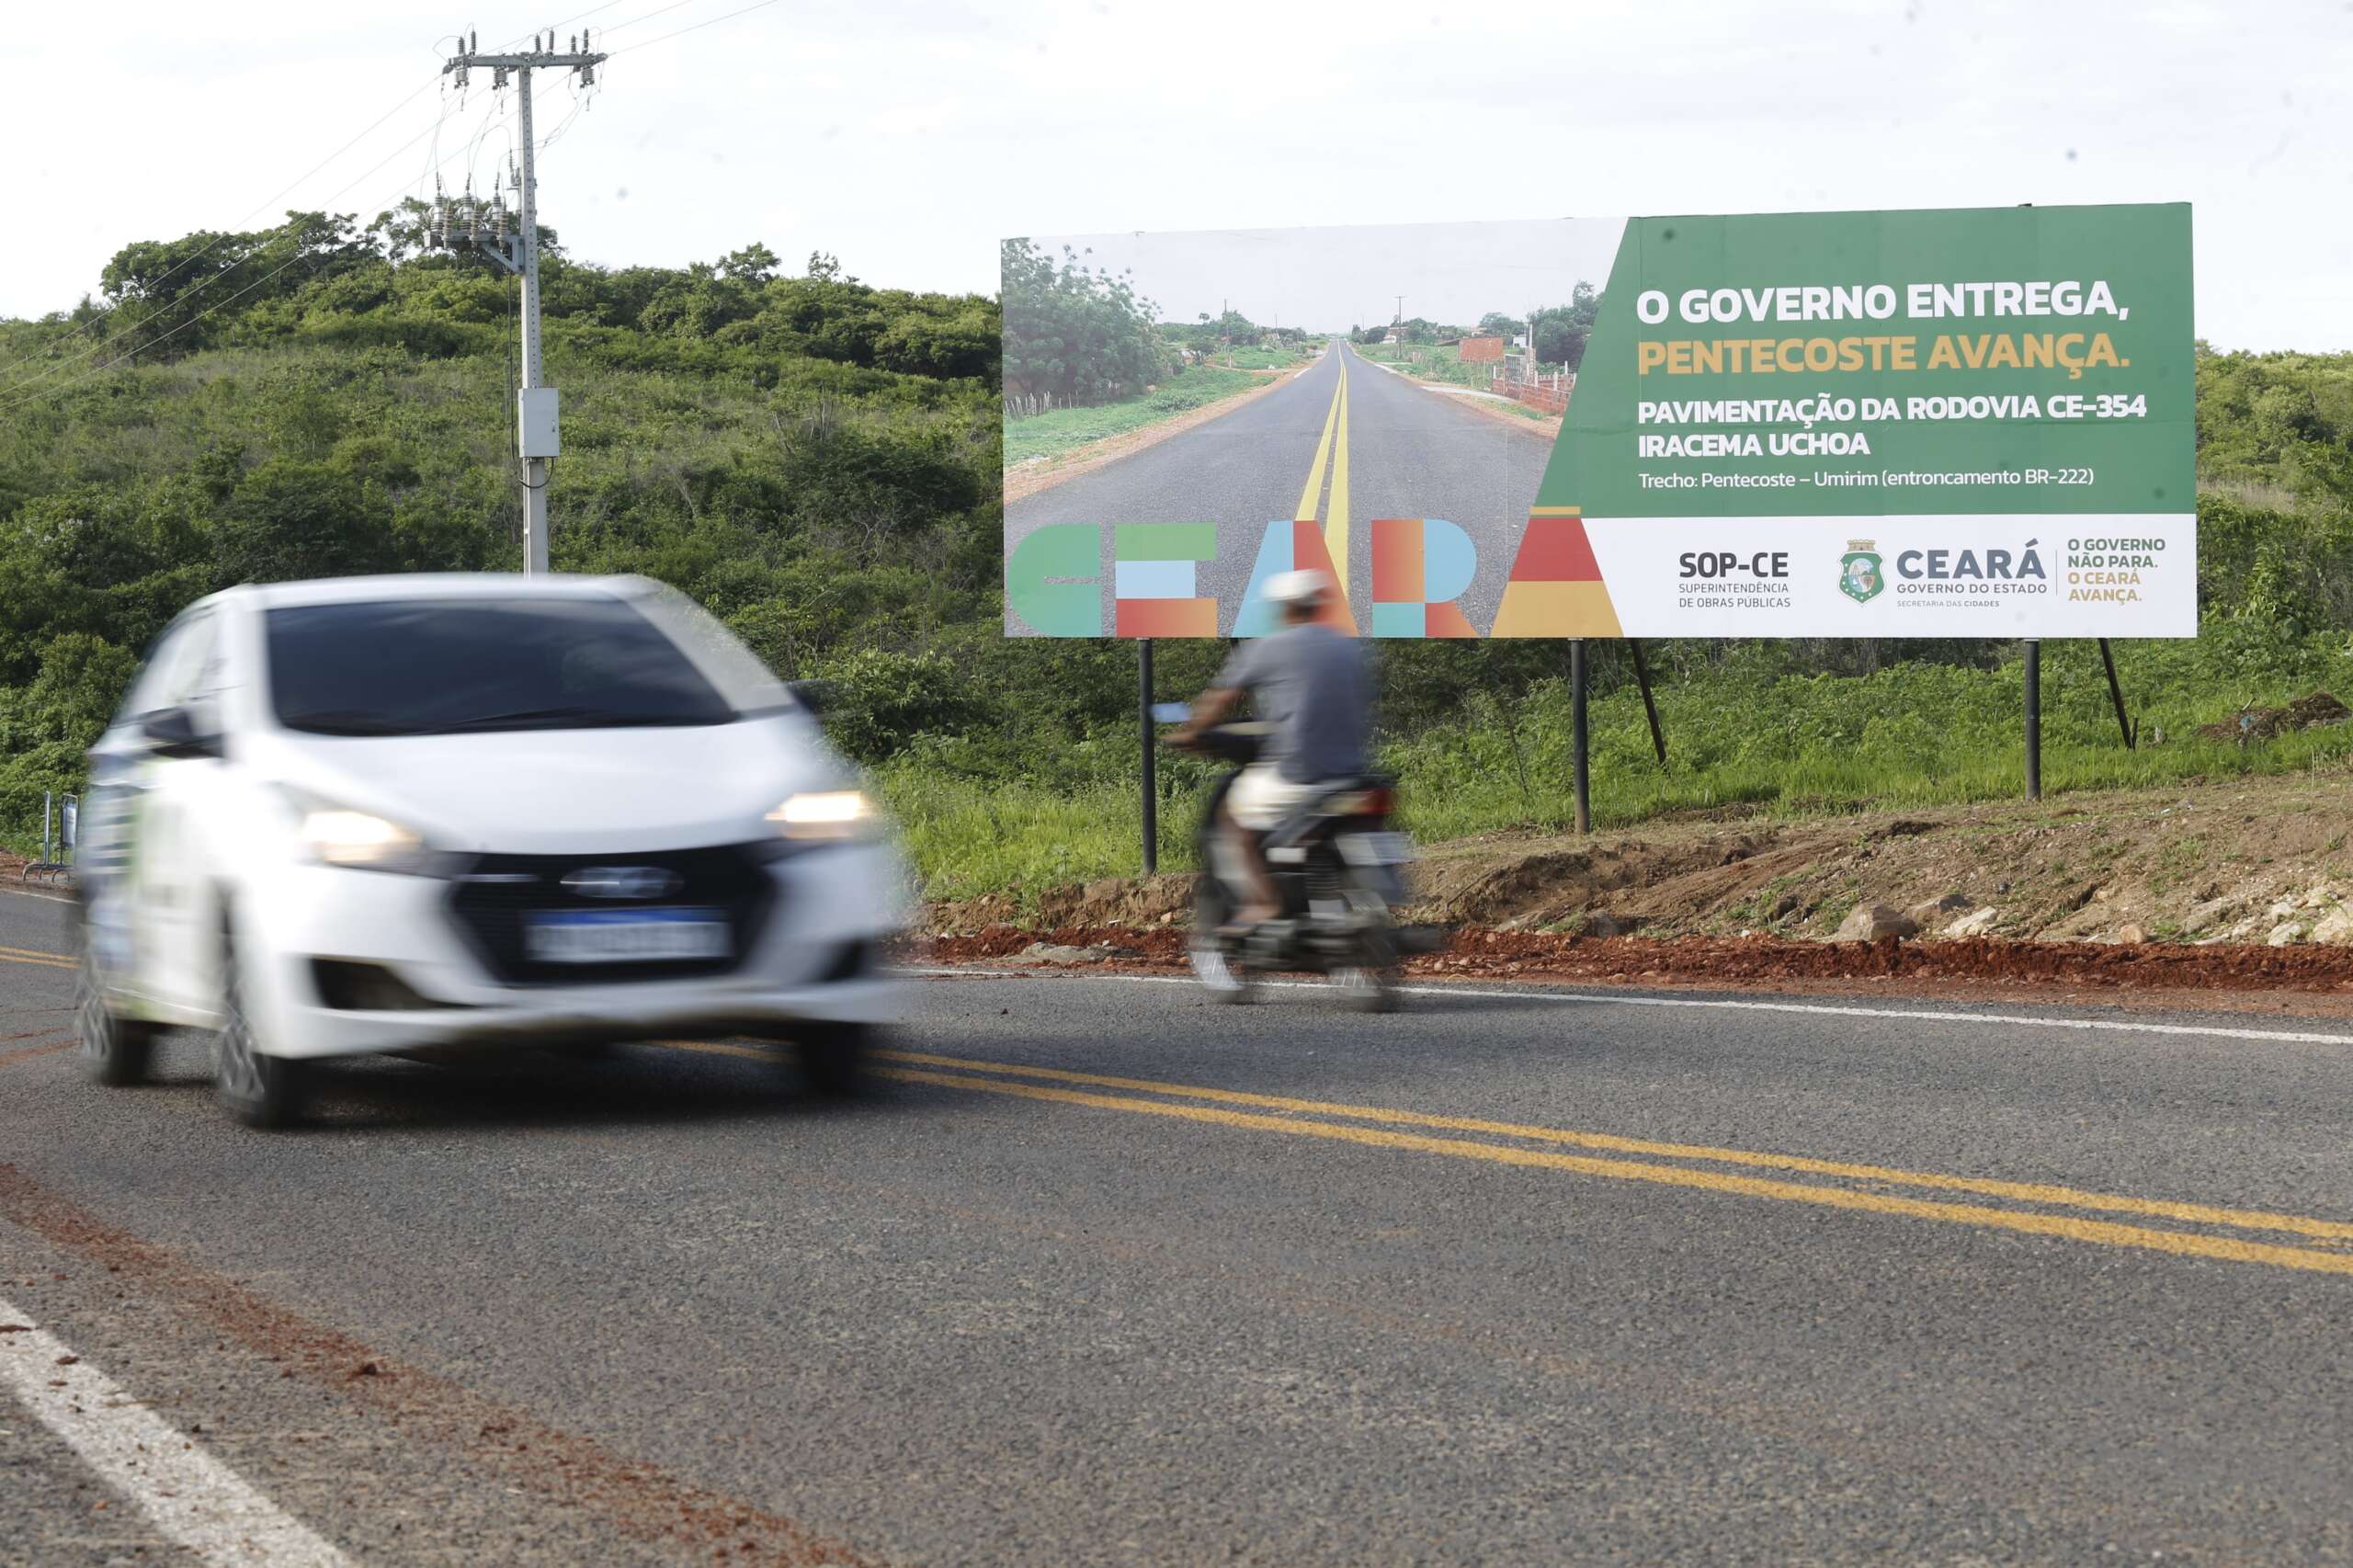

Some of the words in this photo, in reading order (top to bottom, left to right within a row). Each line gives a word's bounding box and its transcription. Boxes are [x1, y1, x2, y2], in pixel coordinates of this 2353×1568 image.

[1636, 290, 1669, 324] O
[1678, 284, 1897, 324] GOVERNO
[1906, 280, 2130, 321] ENTREGA,
[1638, 335, 1917, 375] PENTECOSTE
[1927, 333, 2131, 381] AVANÇA.
[1638, 392, 1856, 429] PAVIMENTAÇÃO
[1860, 397, 1902, 421] DA
[1907, 395, 2041, 420] RODOVIA
[2047, 393, 2147, 418] CE-354
[1638, 434, 1764, 458] IRACEMA
[1768, 432, 1871, 456] UCHOA
[1638, 472, 1699, 489] Trecho:
[1701, 471, 1795, 489] Pentecoste
[1814, 471, 1879, 487] Umirim
[1881, 470, 2021, 487] (entroncamento
[2025, 468, 2094, 486] BR-222)
[2067, 539, 2080, 551] O
[2084, 539, 2165, 551] GOVERNO
[1679, 551, 1789, 578] SOP-CE
[1896, 538, 2047, 580] CEARÁ
[2068, 551, 2104, 568] NÃO
[2109, 555, 2158, 568] PARA.
[2067, 572, 2080, 585] O
[2084, 568, 2140, 585] CEARÁ
[1678, 581, 1789, 593] SUPERINTENDÊNCIA
[1897, 584, 1964, 594] GOVERNO
[1969, 584, 1990, 594] DO
[1994, 584, 2048, 594] ESTADO
[1679, 597, 1694, 608] DE
[1697, 597, 1733, 608] OBRAS
[1737, 596, 1790, 608] PÚBLICAS
[2068, 588, 2143, 606] AVANÇA.
